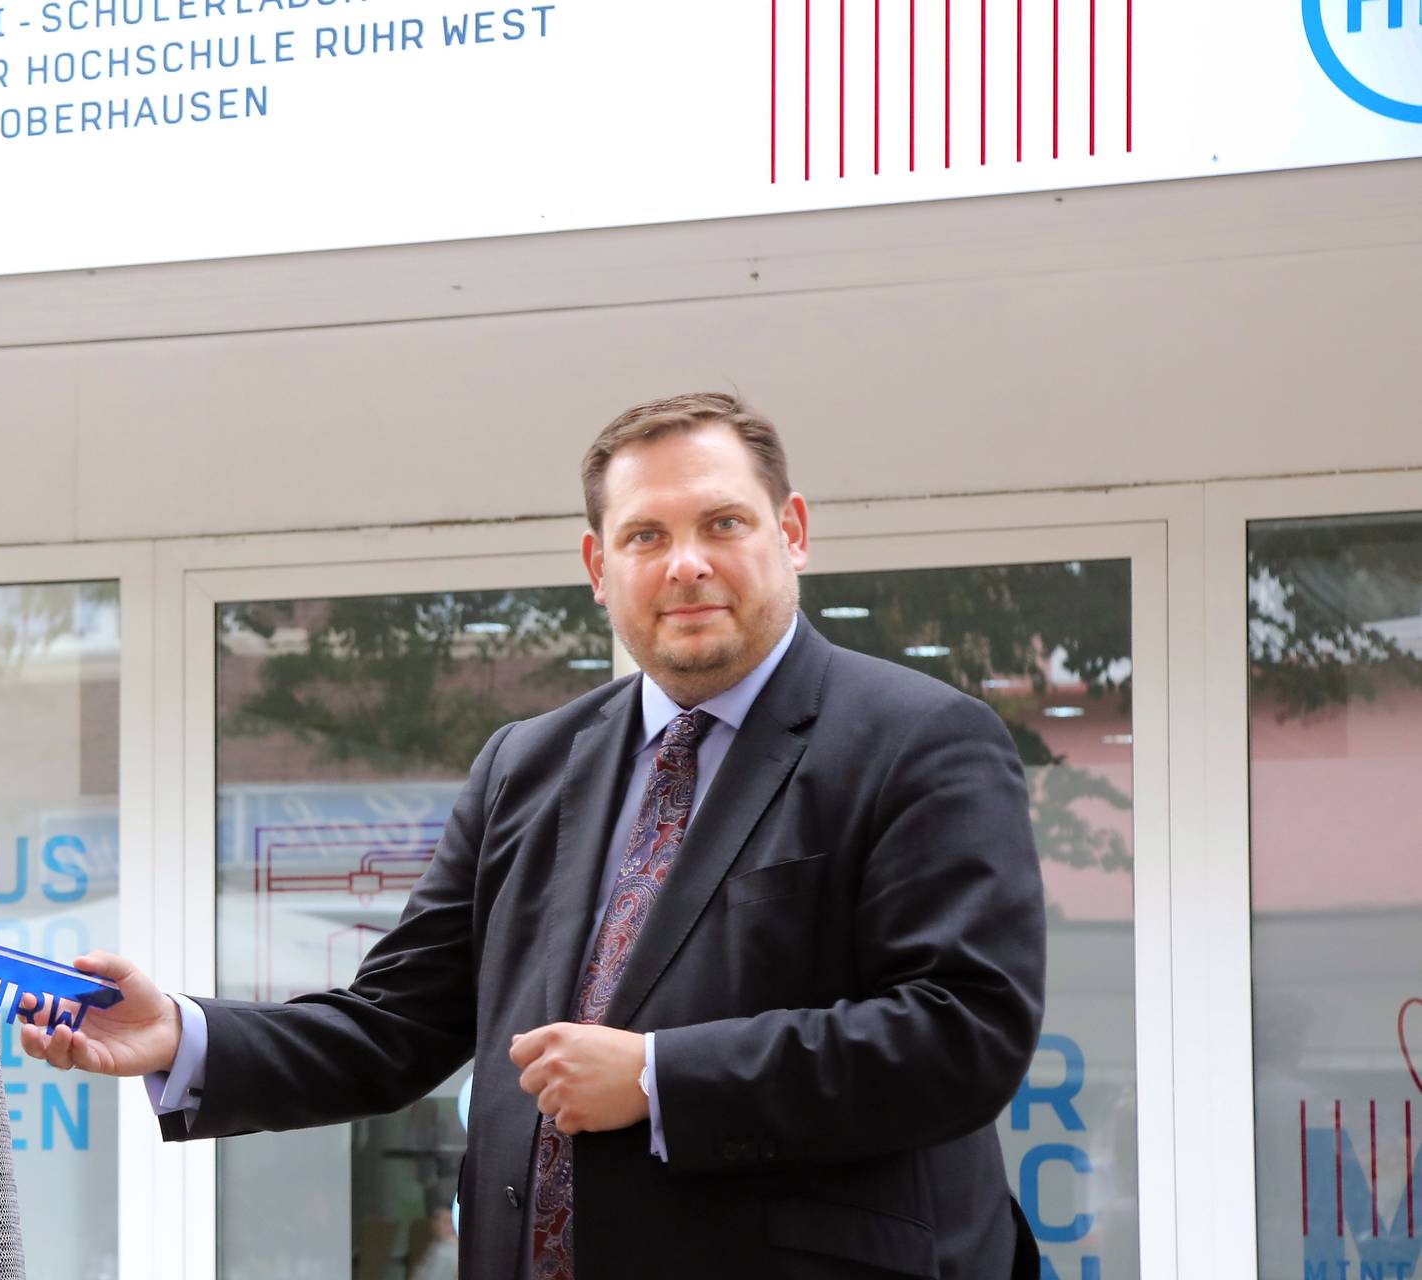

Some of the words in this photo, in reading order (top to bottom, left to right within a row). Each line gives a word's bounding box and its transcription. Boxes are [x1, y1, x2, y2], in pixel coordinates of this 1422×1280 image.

[27, 30, 295, 85] HOCHSCHULE
[315, 18, 425, 58] RUHR
[442, 5, 556, 46] WEST
[0, 86, 268, 139] OBERHAUSEN
